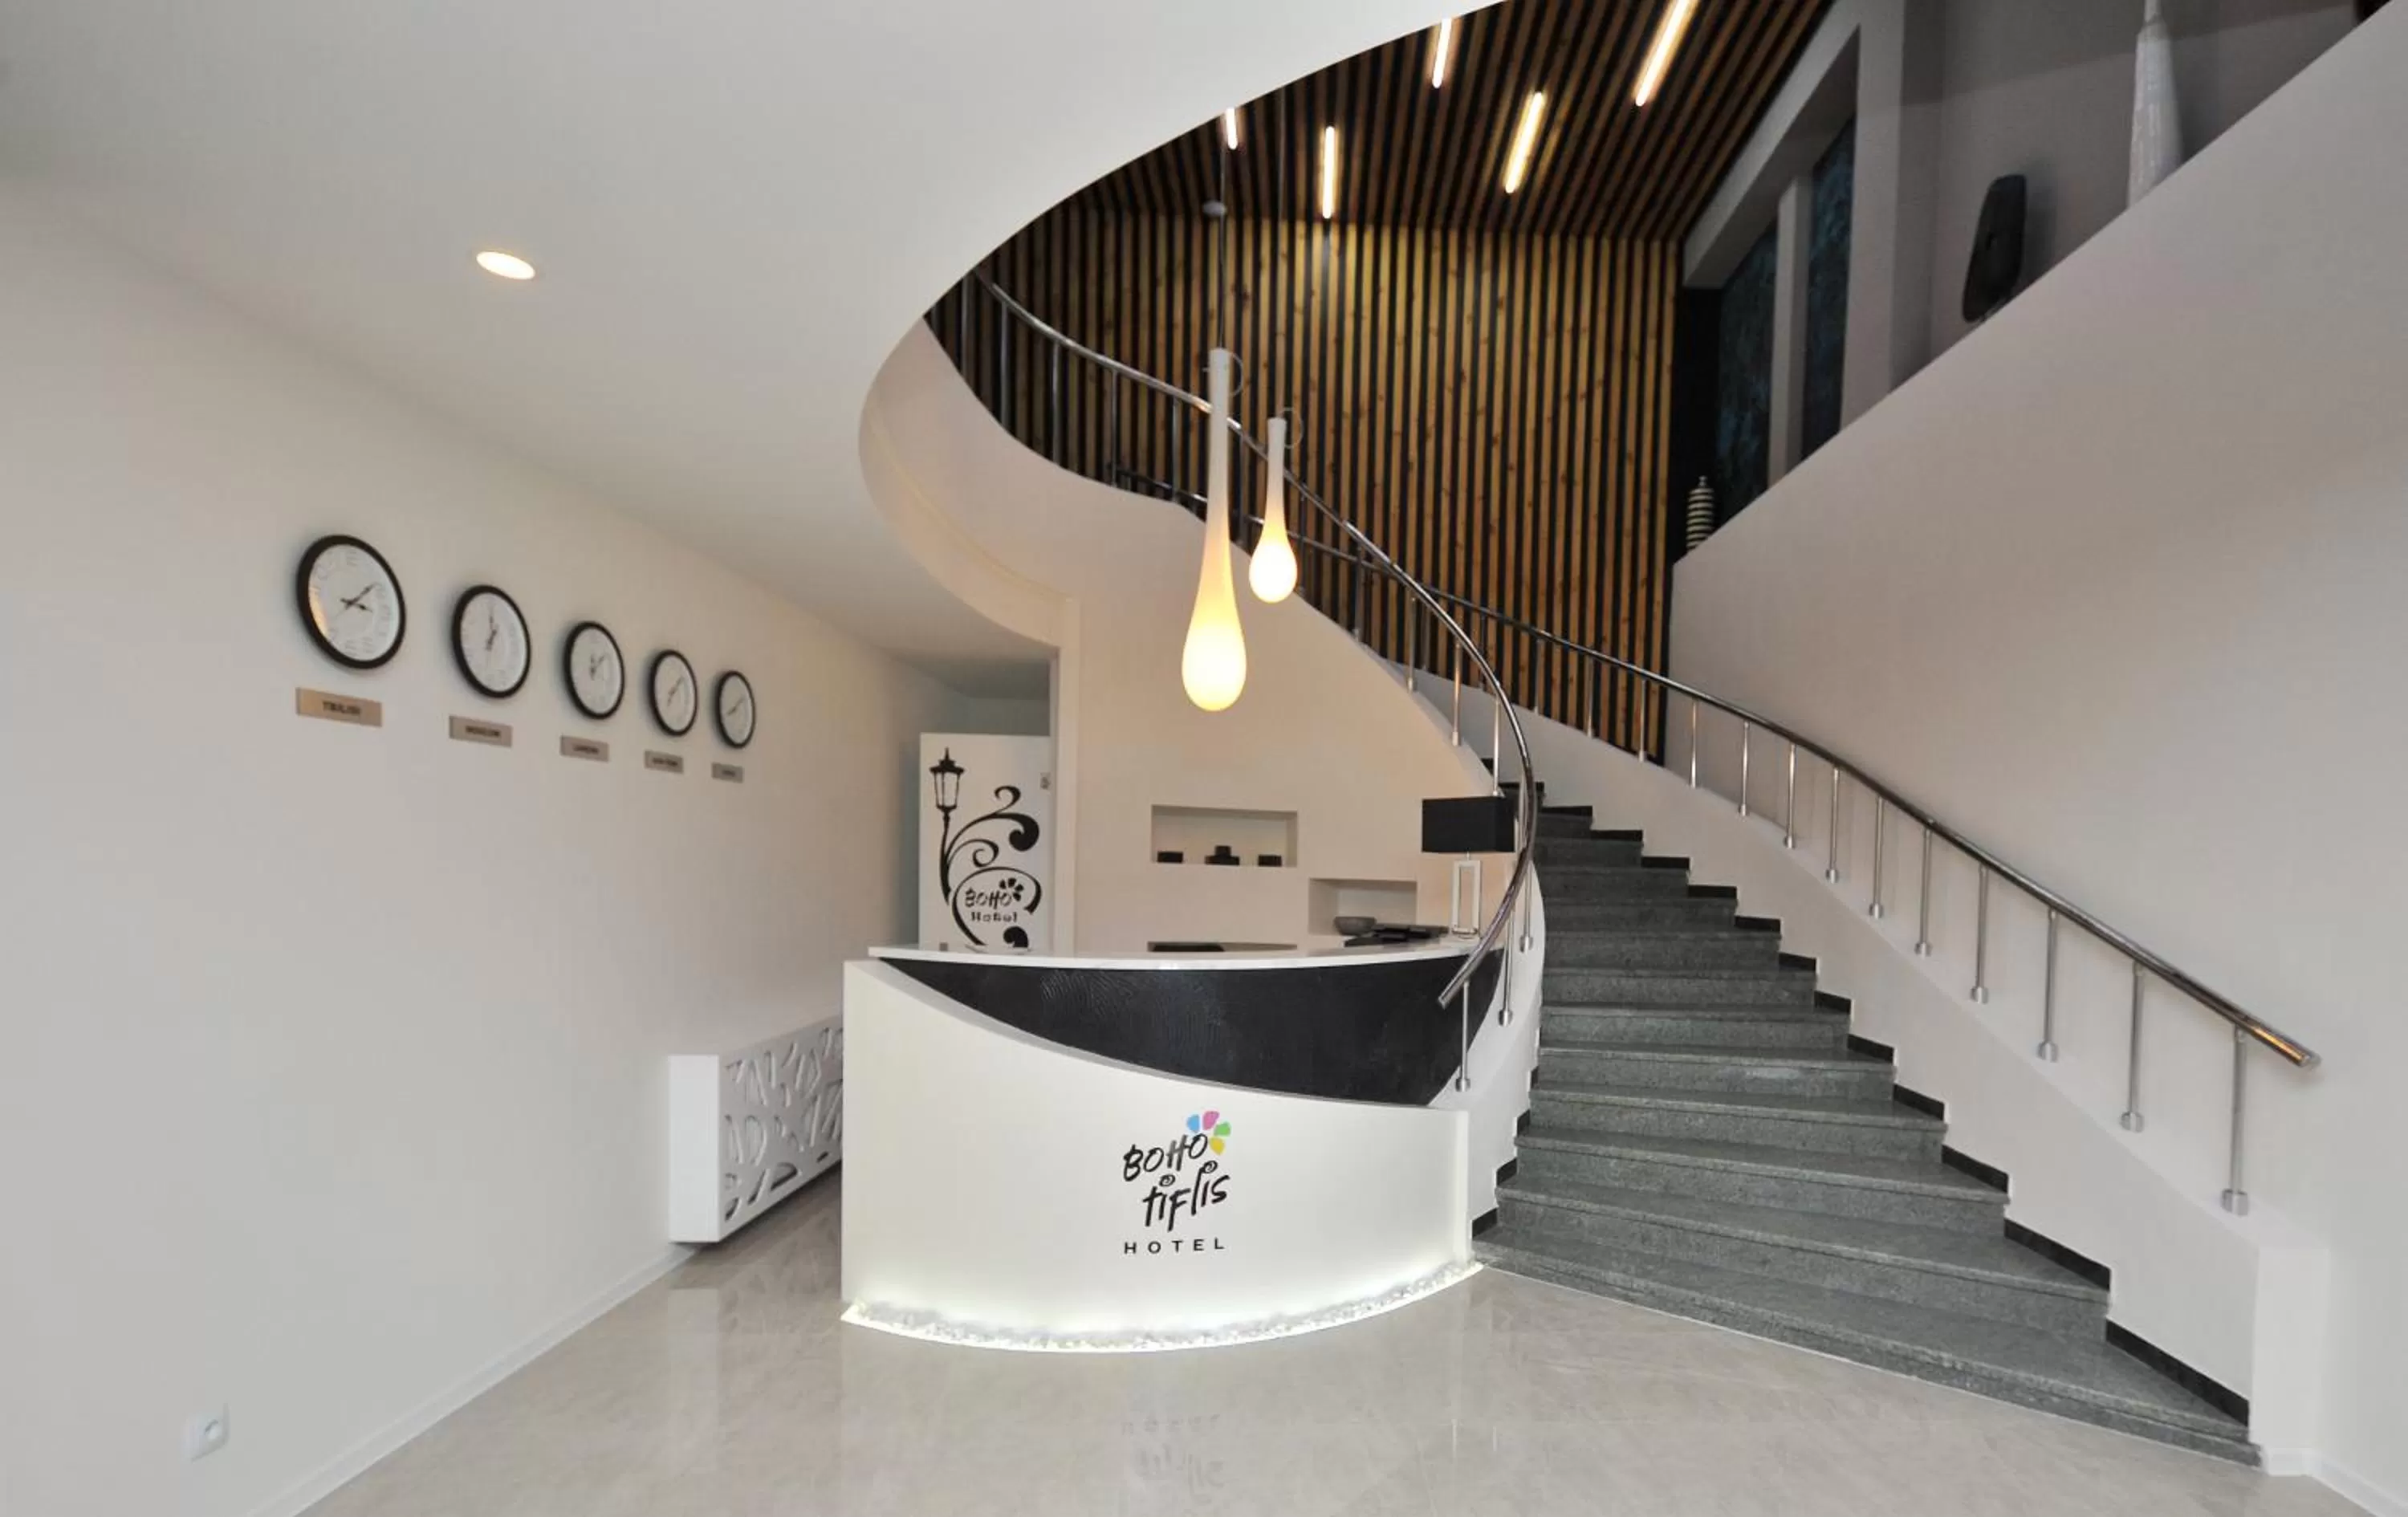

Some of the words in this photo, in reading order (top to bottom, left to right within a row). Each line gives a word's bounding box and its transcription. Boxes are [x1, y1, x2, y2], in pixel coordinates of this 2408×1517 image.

[965, 887, 1012, 909] BOHO
[1122, 1132, 1209, 1182] BOHO
[1124, 1238, 1226, 1255] HOTEL
